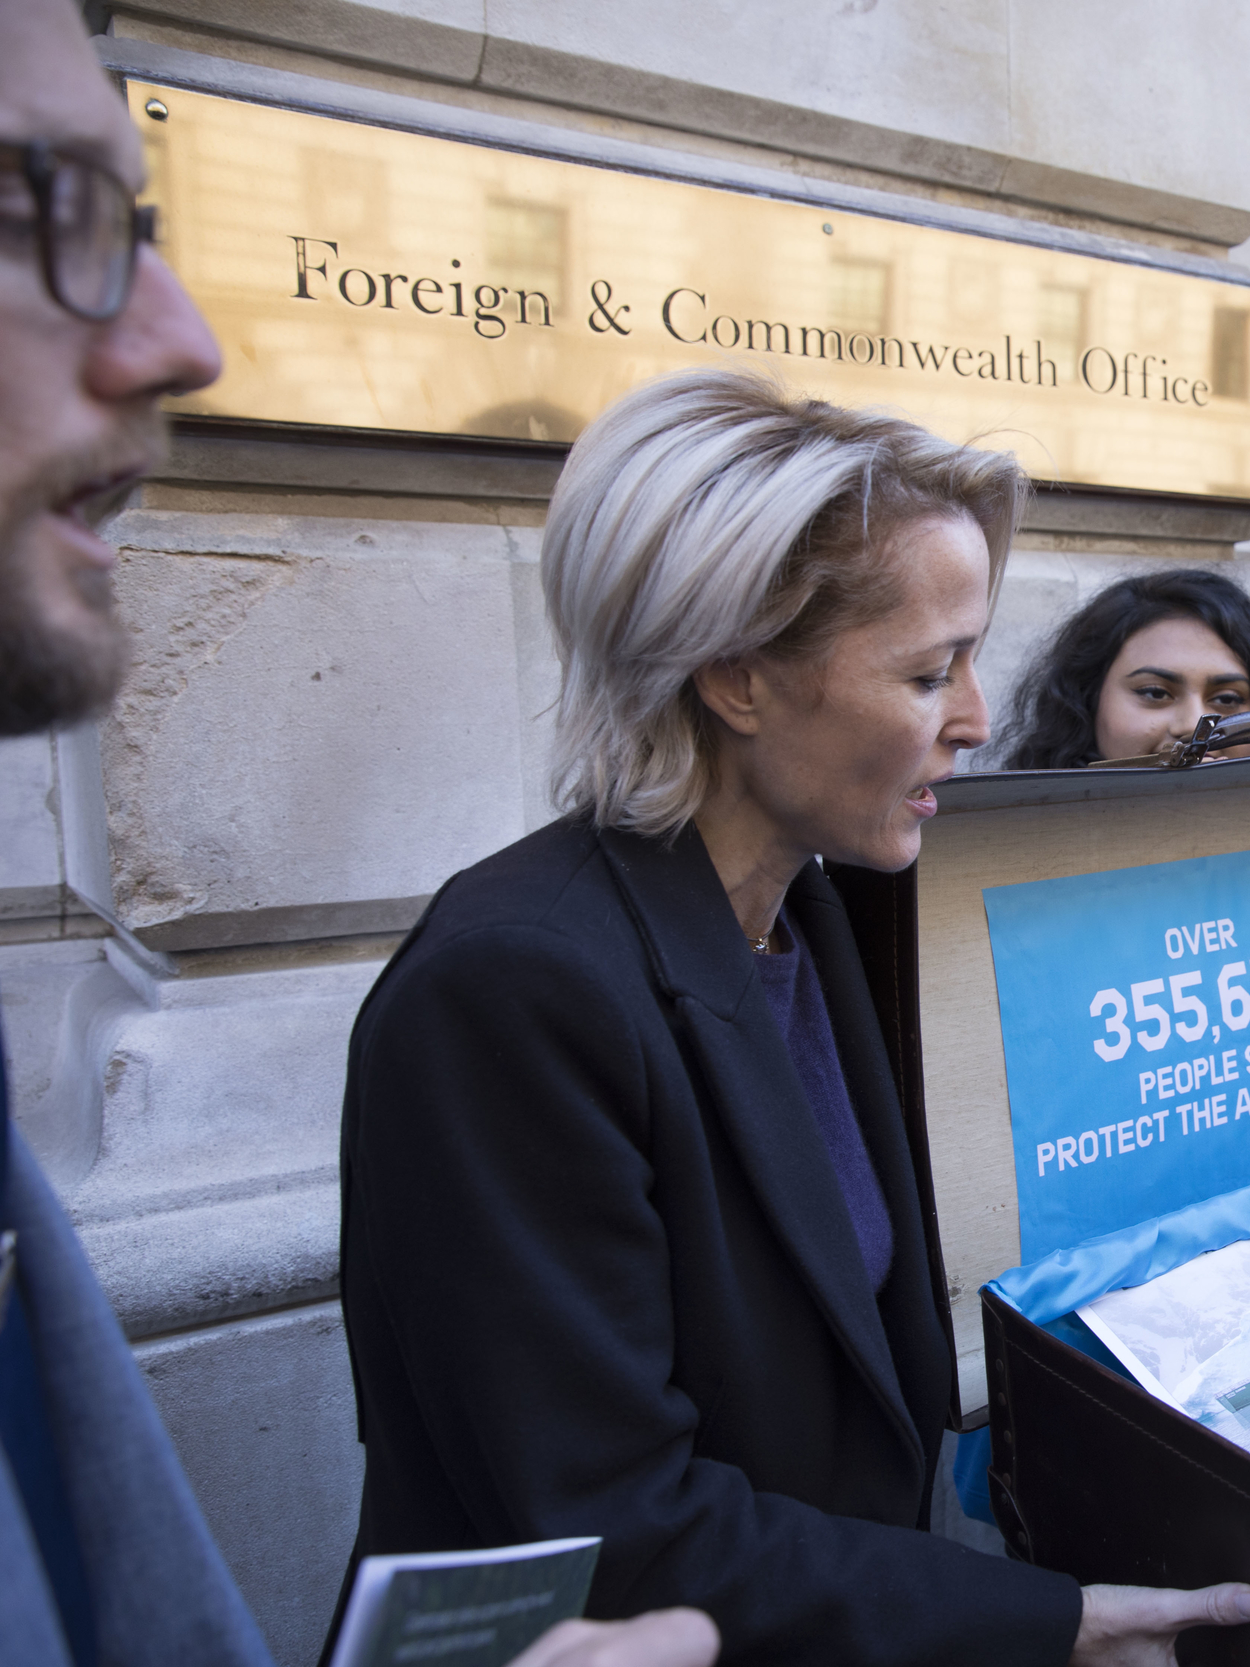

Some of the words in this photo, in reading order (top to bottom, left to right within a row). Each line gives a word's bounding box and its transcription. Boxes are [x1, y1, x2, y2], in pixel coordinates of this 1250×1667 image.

[286, 234, 555, 339] Foreign
[588, 278, 631, 336] &
[660, 287, 1060, 388] Commonwealth
[1080, 344, 1210, 407] Office
[1164, 917, 1239, 960] OVER
[1139, 1049, 1240, 1105] PEOPLE
[1036, 1109, 1170, 1177] PROTECT
[1175, 1093, 1229, 1136] THE
